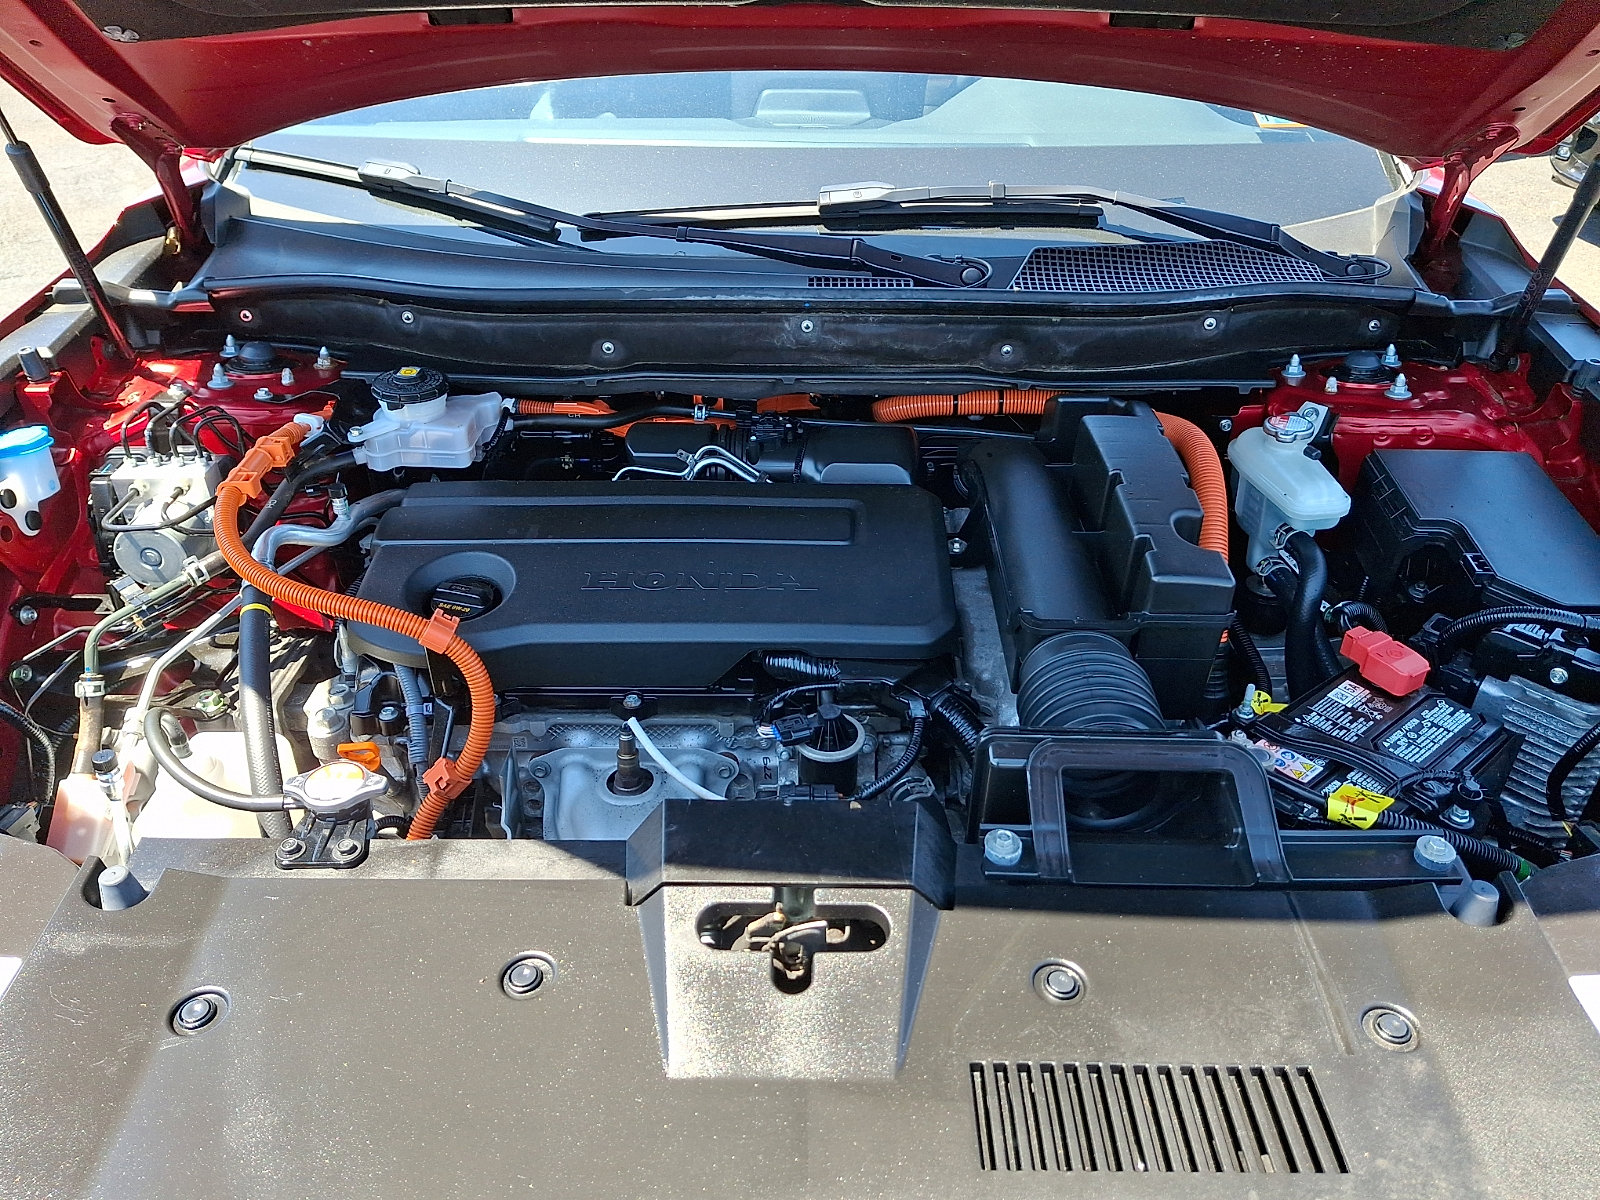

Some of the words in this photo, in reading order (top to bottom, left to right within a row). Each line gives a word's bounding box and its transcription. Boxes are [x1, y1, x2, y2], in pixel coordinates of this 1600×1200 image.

[580, 571, 819, 591] HONDA
[438, 602, 452, 610] SAE
[762, 756, 772, 780] 279
